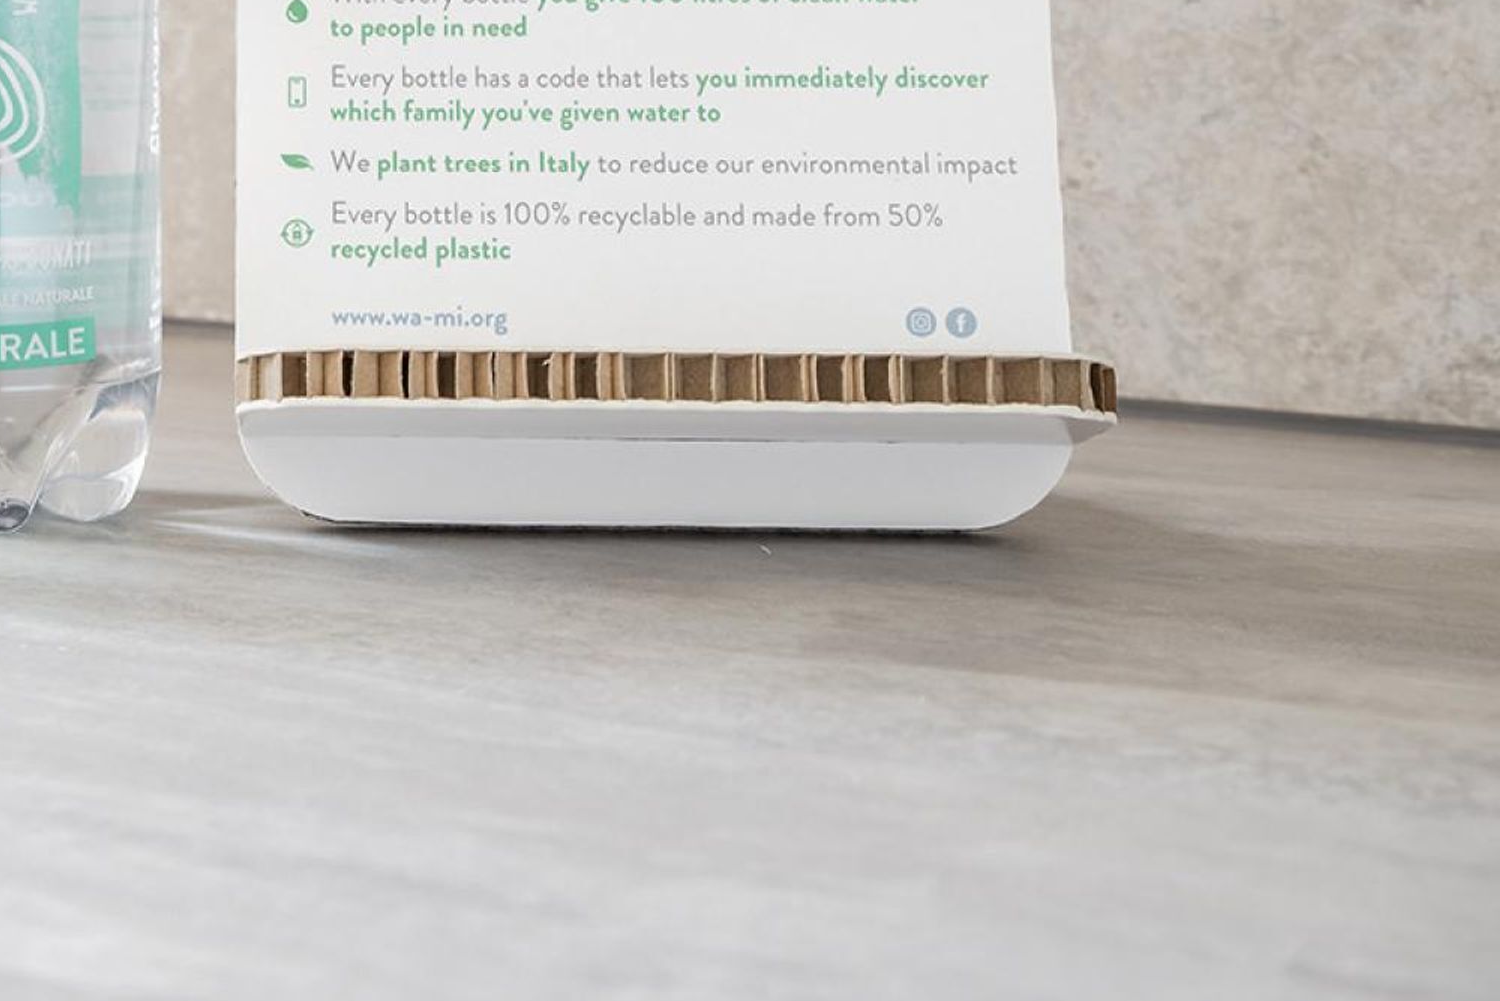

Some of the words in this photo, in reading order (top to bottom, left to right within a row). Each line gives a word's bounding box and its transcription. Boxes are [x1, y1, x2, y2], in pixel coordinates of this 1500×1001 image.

[330, 19, 354, 38] to
[360, 14, 437, 47] people
[443, 15, 465, 38] in
[472, 13, 528, 38] need
[331, 64, 395, 96] Every
[401, 65, 468, 89] bottle
[474, 65, 512, 89] has
[517, 73, 529, 89] a
[535, 65, 590, 89] code
[596, 65, 643, 89] that
[649, 65, 690, 89] lets
[695, 73, 738, 97] you
[744, 64, 889, 97] immediately
[894, 65, 990, 89] discover
[329, 98, 397, 122] which
[402, 98, 476, 131] family
[480, 99, 554, 132] you've
[559, 99, 620, 132] given
[626, 103, 691, 123] water
[696, 103, 722, 123] to
[330, 149, 371, 173] We
[377, 149, 437, 182] plant
[443, 154, 502, 173] trees
[508, 151, 530, 173] in
[539, 150, 591, 183] Italy
[597, 156, 622, 174] to
[629, 151, 709, 174] reduce
[715, 159, 755, 175] our
[761, 151, 930, 175] environmental
[936, 152, 1018, 183] impact
[331, 200, 397, 233] Every
[404, 201, 473, 225] bottle
[480, 202, 497, 225] is
[504, 201, 571, 226] 100%
[578, 202, 697, 234] recyclable
[703, 203, 745, 227] and
[752, 203, 816, 227] made
[823, 202, 880, 227] from
[888, 202, 943, 227] 50%
[330, 235, 428, 269] recycled
[435, 236, 512, 269] plastic
[23, 285, 95, 308] NATURALE
[331, 305, 508, 336] www.wa-mi.org
